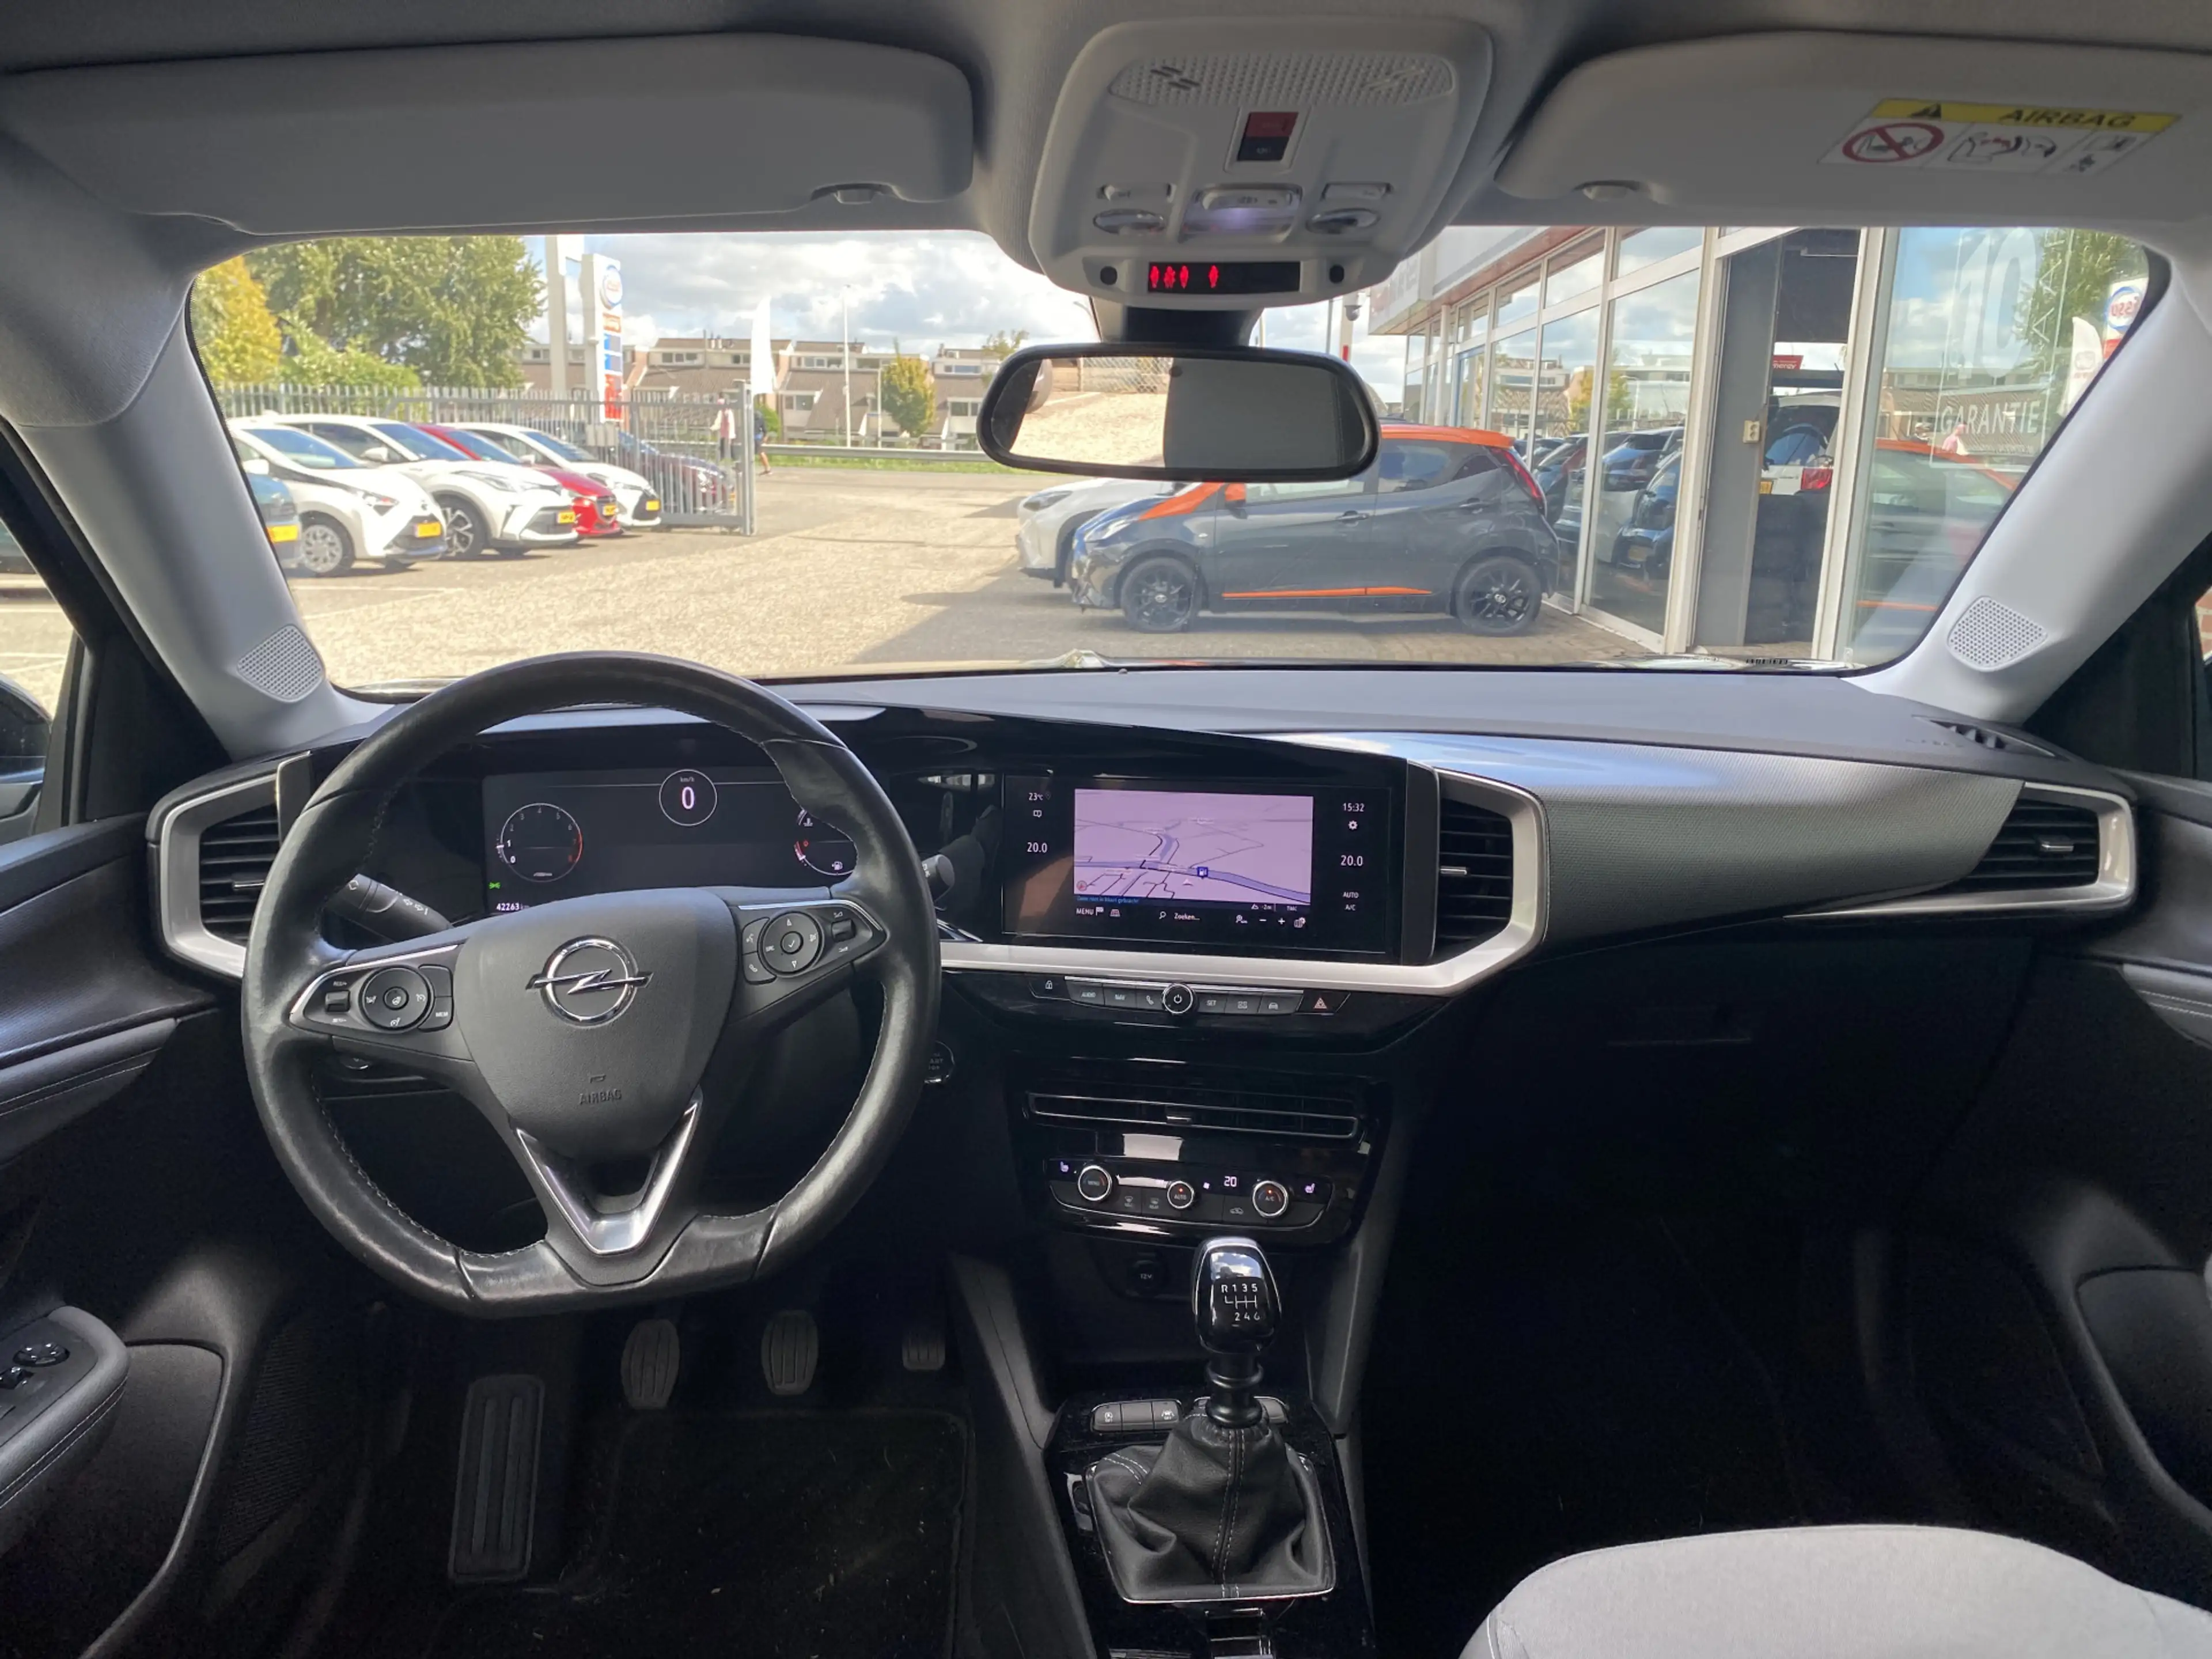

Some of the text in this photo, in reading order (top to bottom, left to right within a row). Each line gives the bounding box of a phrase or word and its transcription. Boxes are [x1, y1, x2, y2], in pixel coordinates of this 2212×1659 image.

[1999, 109, 2137, 128] AIRBAG
[1941, 399, 2041, 434] GARANTIE
[681, 786, 695, 809] 0
[1342, 802, 1365, 812] 15:32
[1027, 842, 1048, 853] 20.0
[1340, 855, 1363, 866] 20.0
[496, 903, 520, 911] 42263
[1076, 907, 1094, 915] MENU
[577, 1088, 622, 1105] AIRBAG
[1224, 1176, 1237, 1188] 20
[1221, 1284, 1228, 1293] R
[1242, 1283, 1247, 1291] 3
[1251, 1283, 1257, 1292] 5
[1235, 1312, 1260, 1321] 2 4 6
